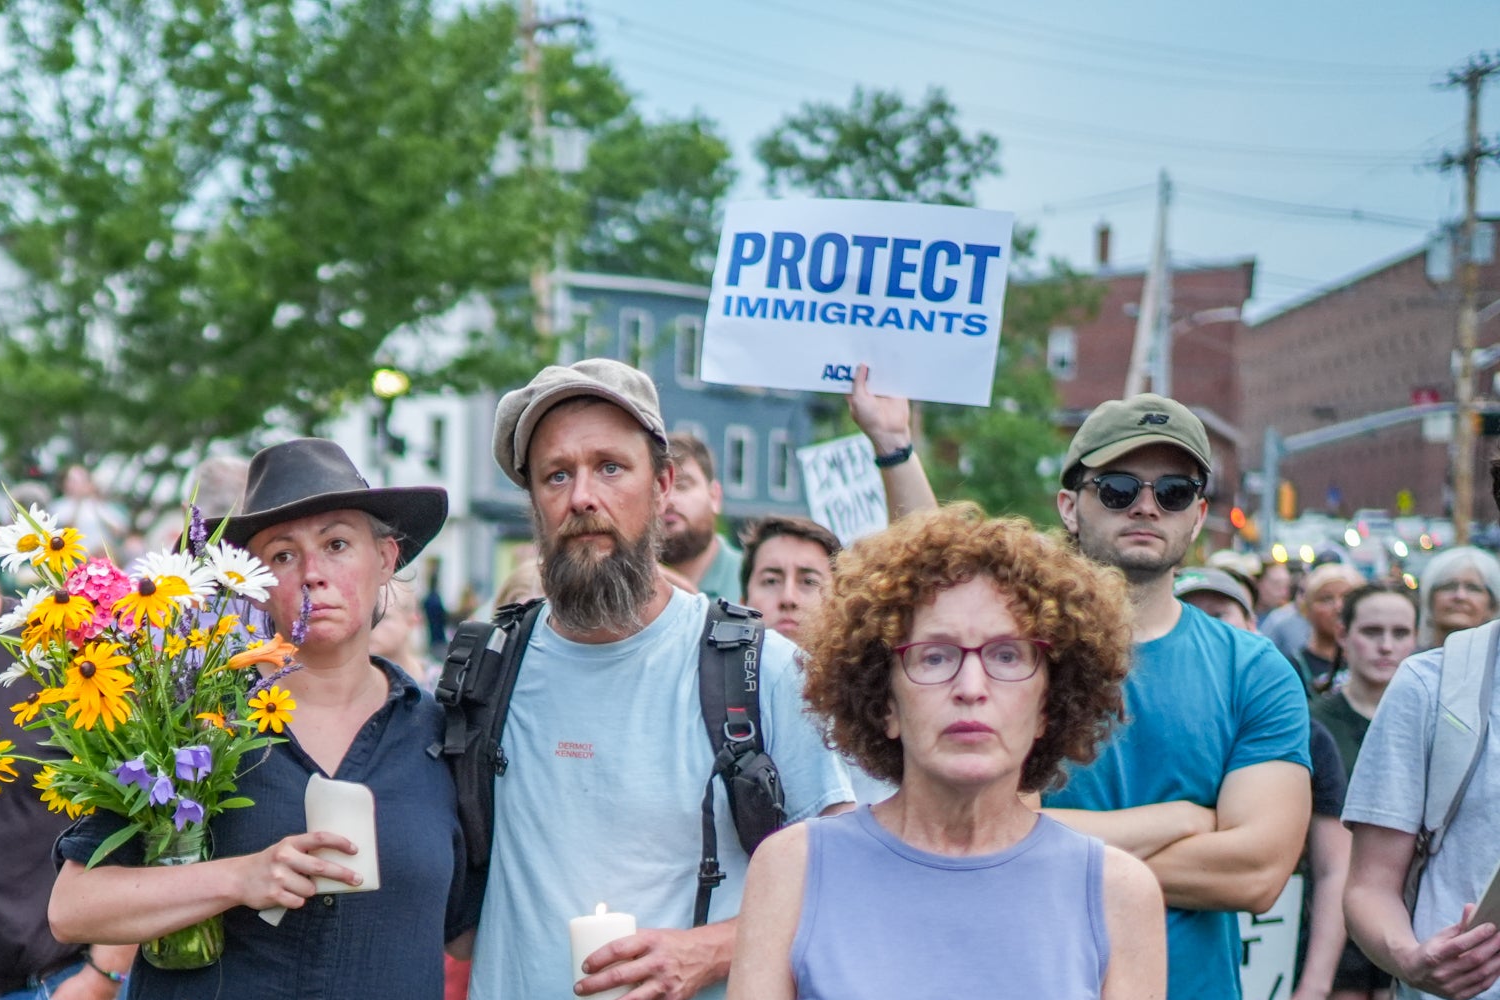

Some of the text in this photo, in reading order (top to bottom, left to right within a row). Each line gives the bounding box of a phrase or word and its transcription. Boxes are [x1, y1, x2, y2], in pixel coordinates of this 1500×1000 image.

[725, 231, 1000, 305] PROTECT
[722, 295, 988, 336] IMMIGRANTS
[821, 364, 869, 382] ACL
[554, 750, 594, 759] KENNEDY
[557, 741, 593, 751] DERMOT
